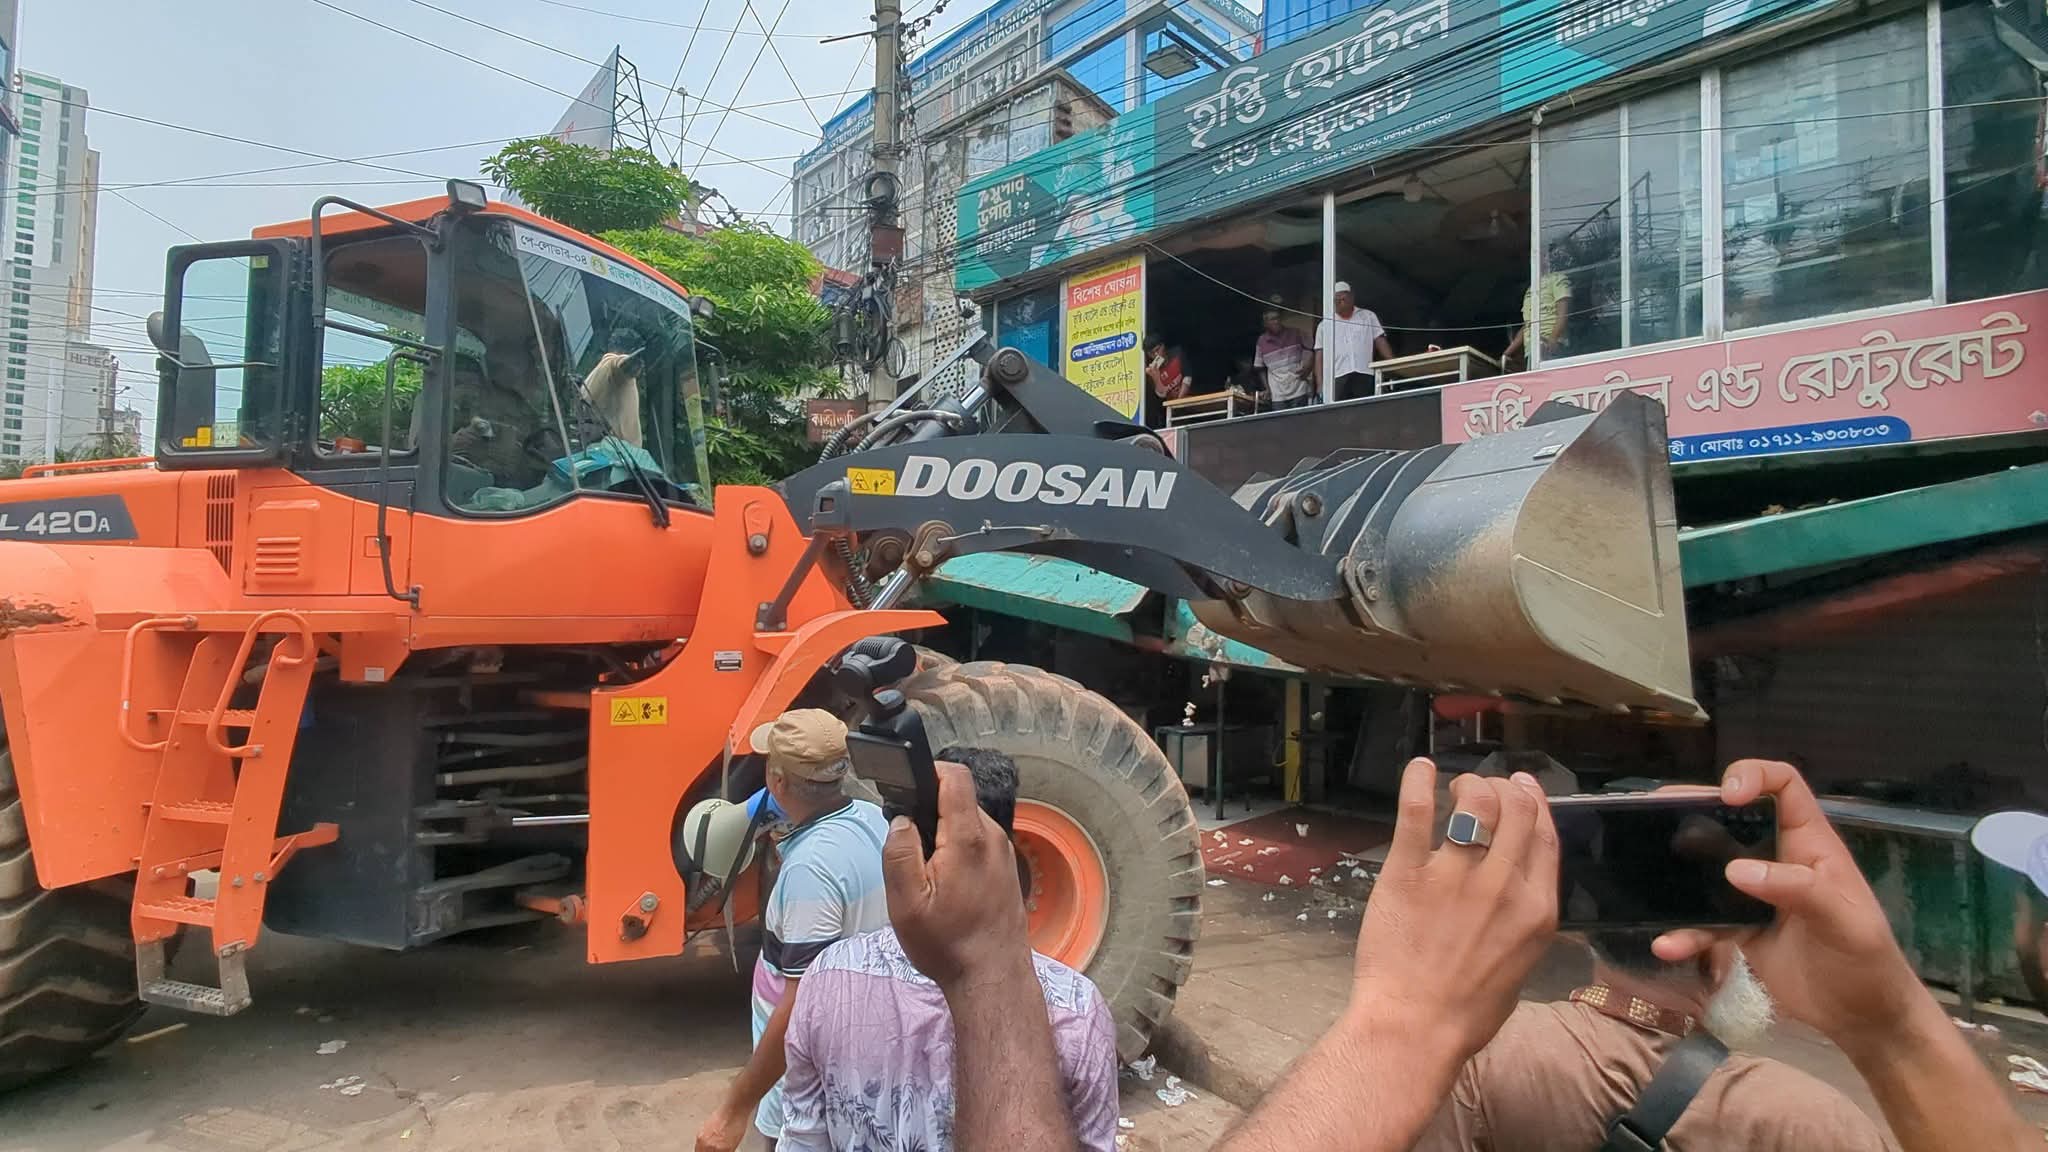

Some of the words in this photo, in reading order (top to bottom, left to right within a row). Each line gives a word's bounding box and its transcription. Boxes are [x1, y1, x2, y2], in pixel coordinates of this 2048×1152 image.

[942, 36, 986, 77] POPULAR
[1184, 65, 1270, 149] তৃপ্তি
[1284, 0, 1449, 99] হোটেল
[1072, 285, 1102, 305] বিশেষ
[1778, 311, 2030, 410] রেস্টুরেন্ট
[1749, 424, 1891, 449] ০১৭১১-৯৩০৮০৩
[895, 455, 1178, 509] DOOSAN
